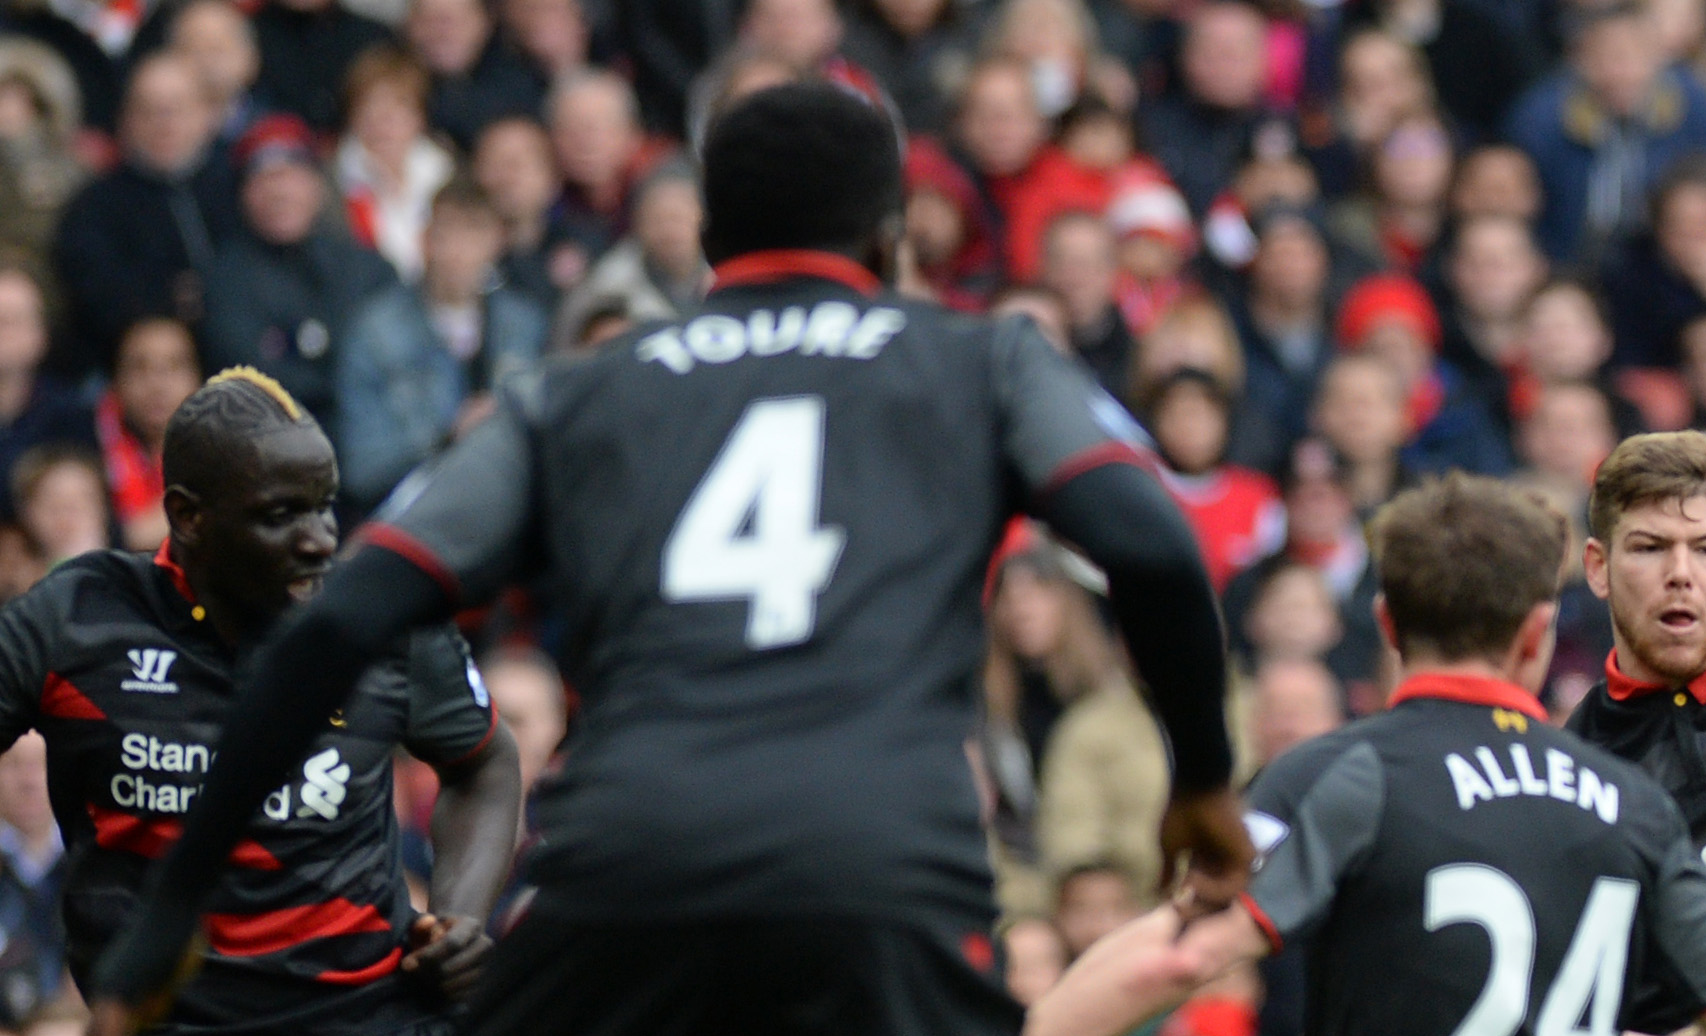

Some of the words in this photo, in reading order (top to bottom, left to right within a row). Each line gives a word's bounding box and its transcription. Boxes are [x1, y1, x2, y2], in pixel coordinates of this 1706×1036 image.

[637, 302, 905, 374] TOURE
[662, 395, 846, 650] 4
[121, 733, 217, 773] Stan
[1445, 743, 1620, 824] ALLEN
